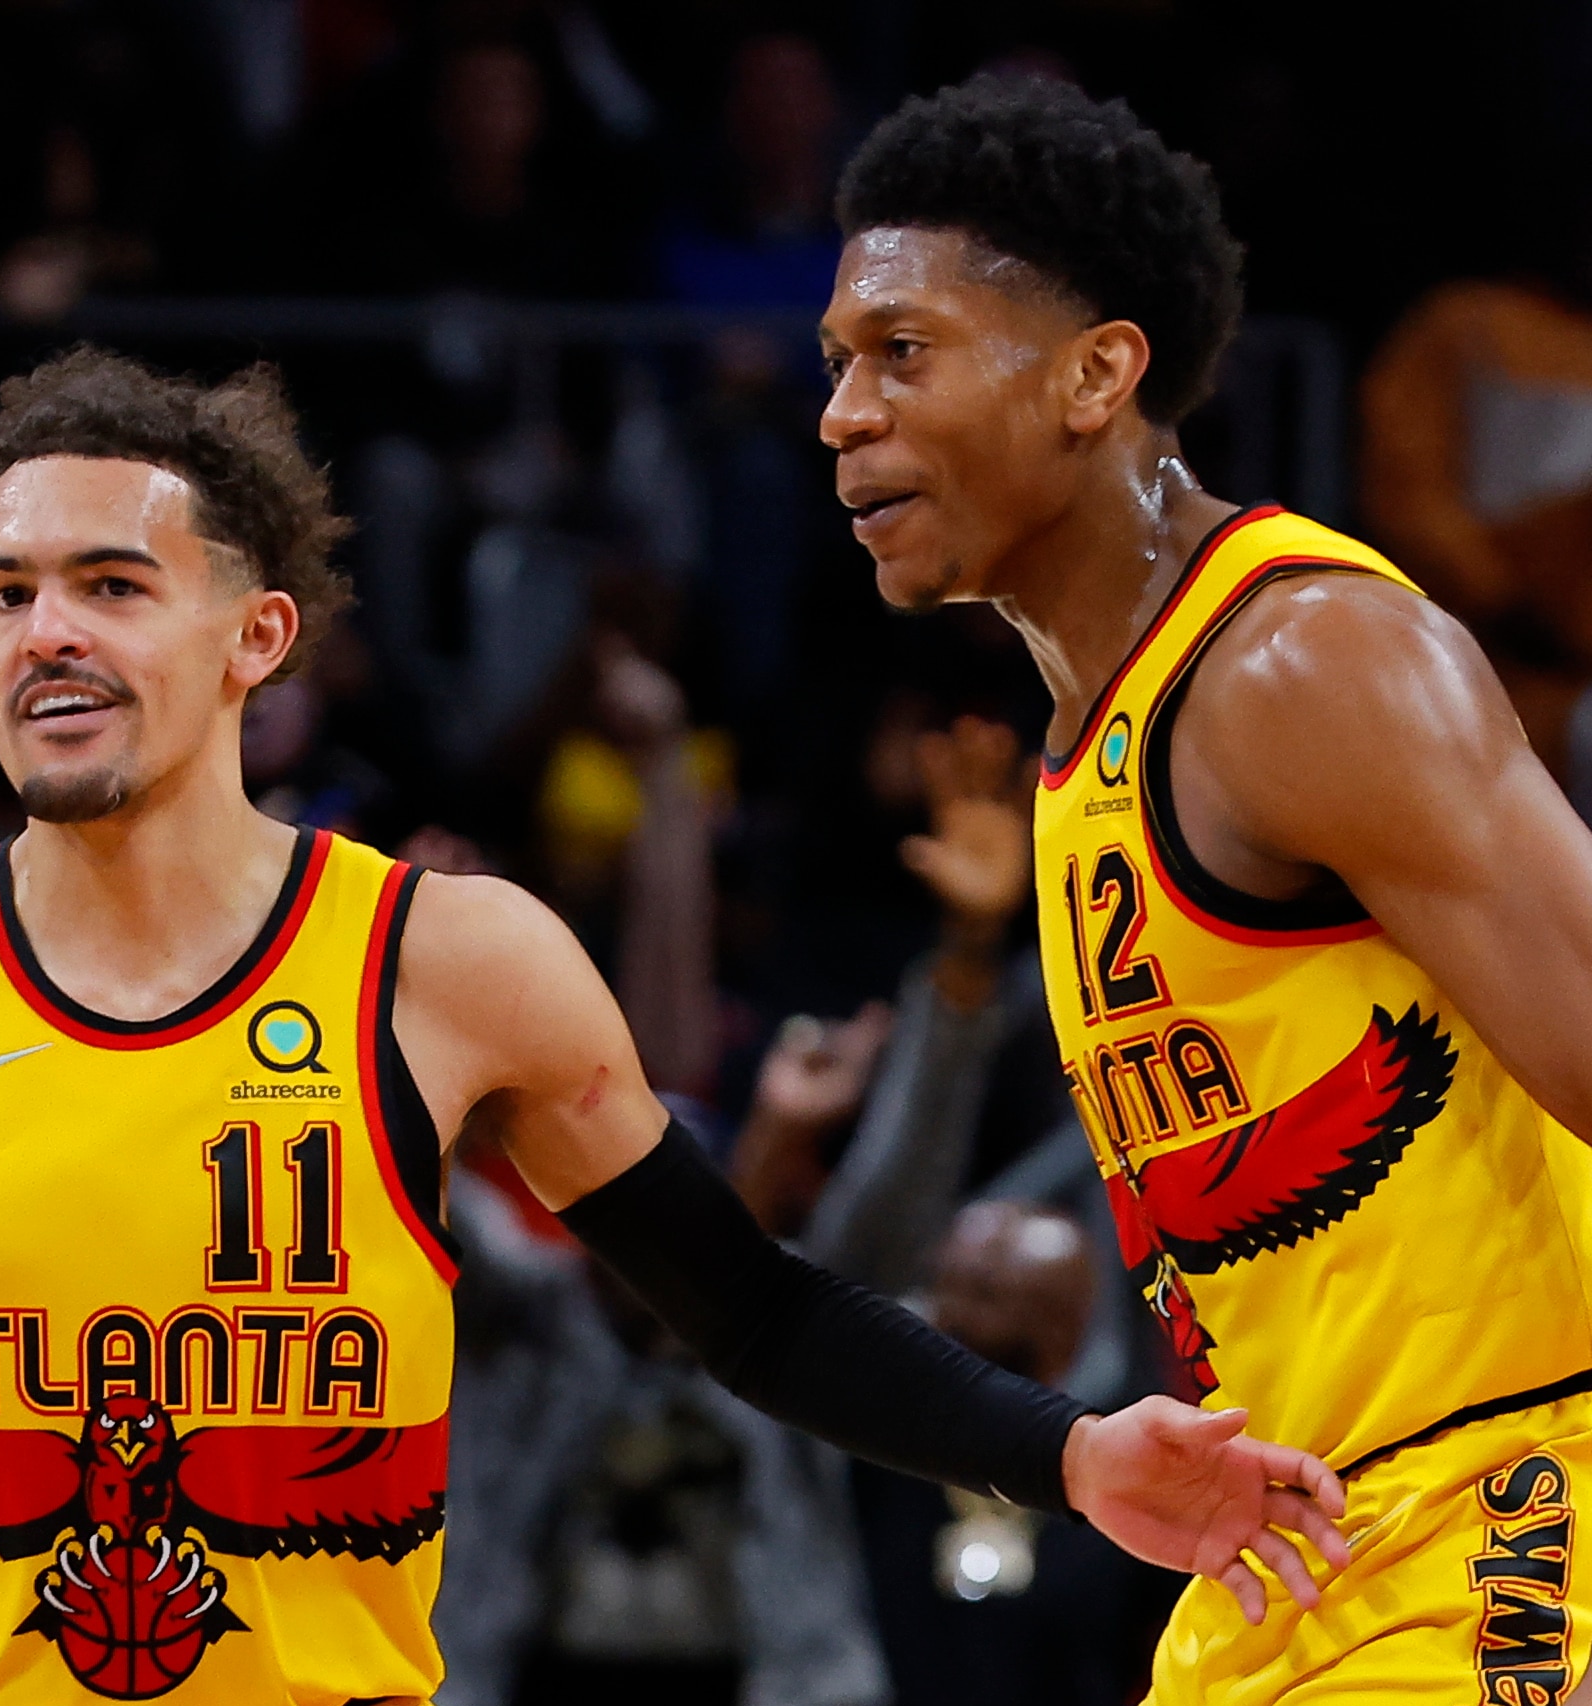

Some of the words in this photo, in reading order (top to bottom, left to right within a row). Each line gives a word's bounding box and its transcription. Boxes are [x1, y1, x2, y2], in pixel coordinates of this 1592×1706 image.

[1063, 842, 1174, 1027] 12
[230, 1080, 342, 1099] sharecare
[203, 1120, 350, 1294] 11
